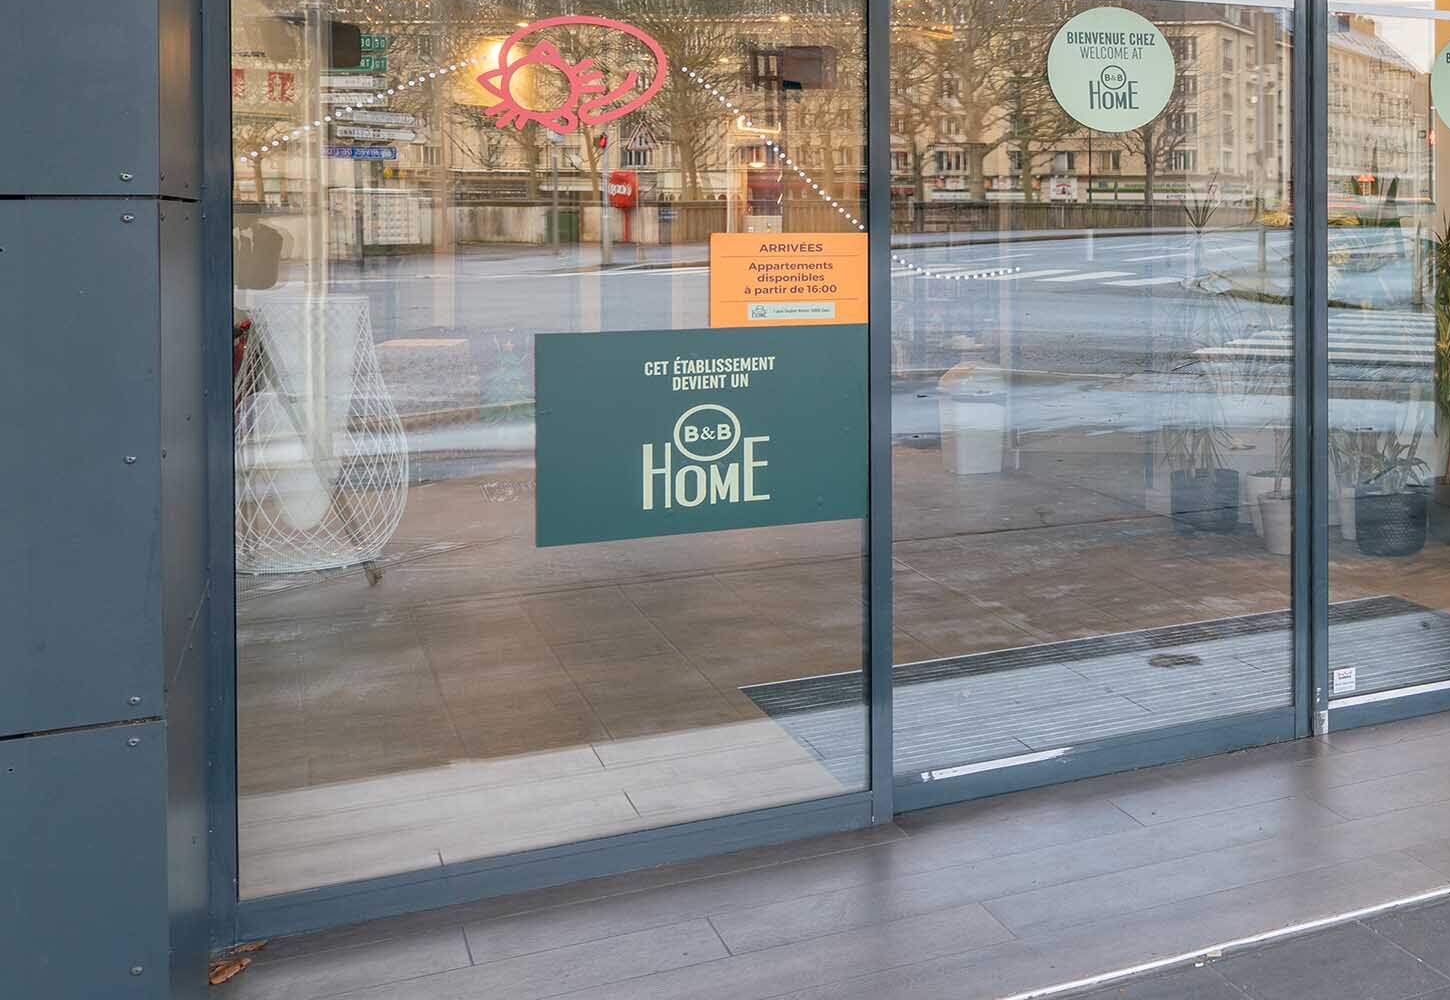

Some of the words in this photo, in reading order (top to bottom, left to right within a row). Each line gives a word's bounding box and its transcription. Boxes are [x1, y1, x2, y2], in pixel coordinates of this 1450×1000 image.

[1067, 32, 1125, 45] BIENVENUE
[1129, 33, 1155, 46] CHEZ
[1080, 46, 1129, 59] WELCOME
[1132, 47, 1143, 60] AT
[1104, 74, 1123, 82] B&B
[760, 242, 823, 253] ARRIVÉES
[749, 262, 833, 272] Appartements
[757, 273, 825, 284] disponibles
[744, 286, 751, 294] à
[754, 285, 787, 296] partir
[790, 285, 804, 294] de
[807, 284, 837, 294] 16:00
[644, 361, 669, 376] CET
[673, 356, 776, 375] ÉTABLISSEMENT
[672, 375, 727, 391] DEVIENT
[731, 374, 749, 388] UN
[684, 424, 732, 442] B&B
